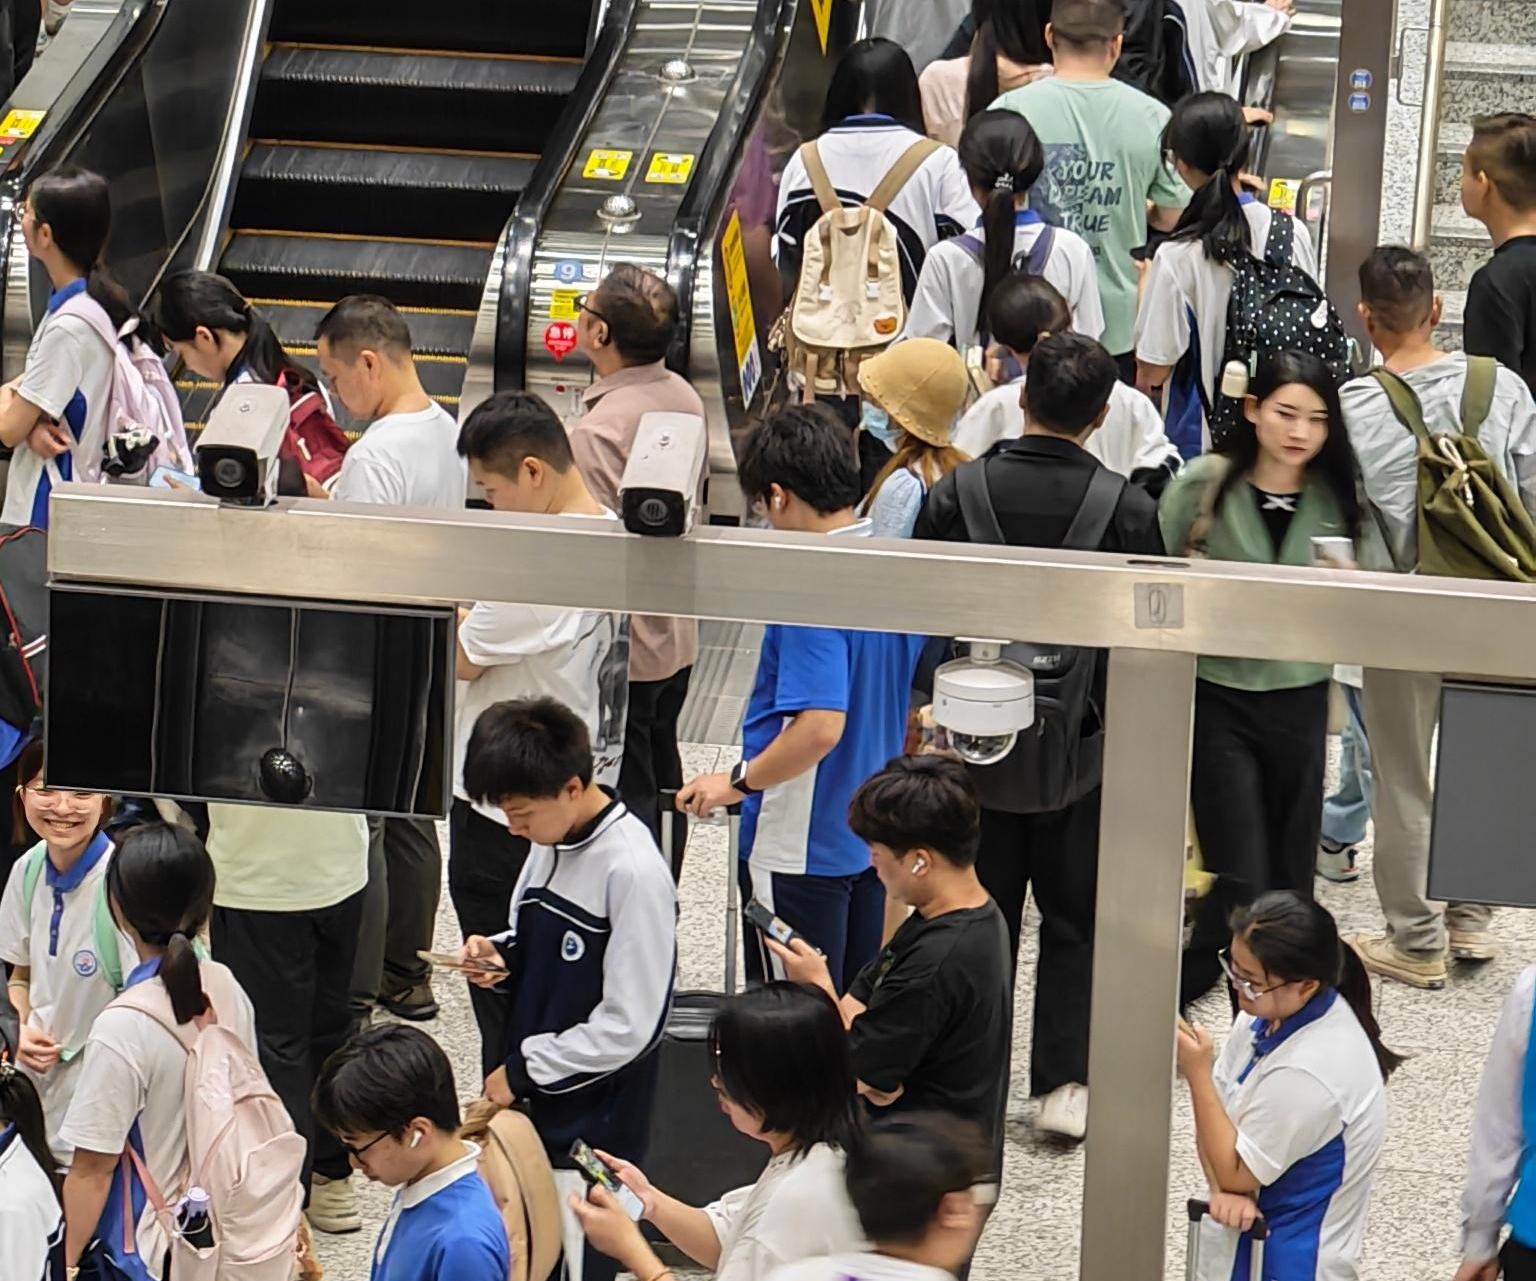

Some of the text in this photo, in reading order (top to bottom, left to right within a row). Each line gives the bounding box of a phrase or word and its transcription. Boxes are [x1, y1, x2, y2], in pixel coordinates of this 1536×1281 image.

[1055, 161, 1116, 182] YOUR
[1048, 185, 1122, 207] DREAM
[1059, 213, 1110, 234] TRUE
[561, 263, 575, 281] 9
[549, 325, 575, 339] 急停
